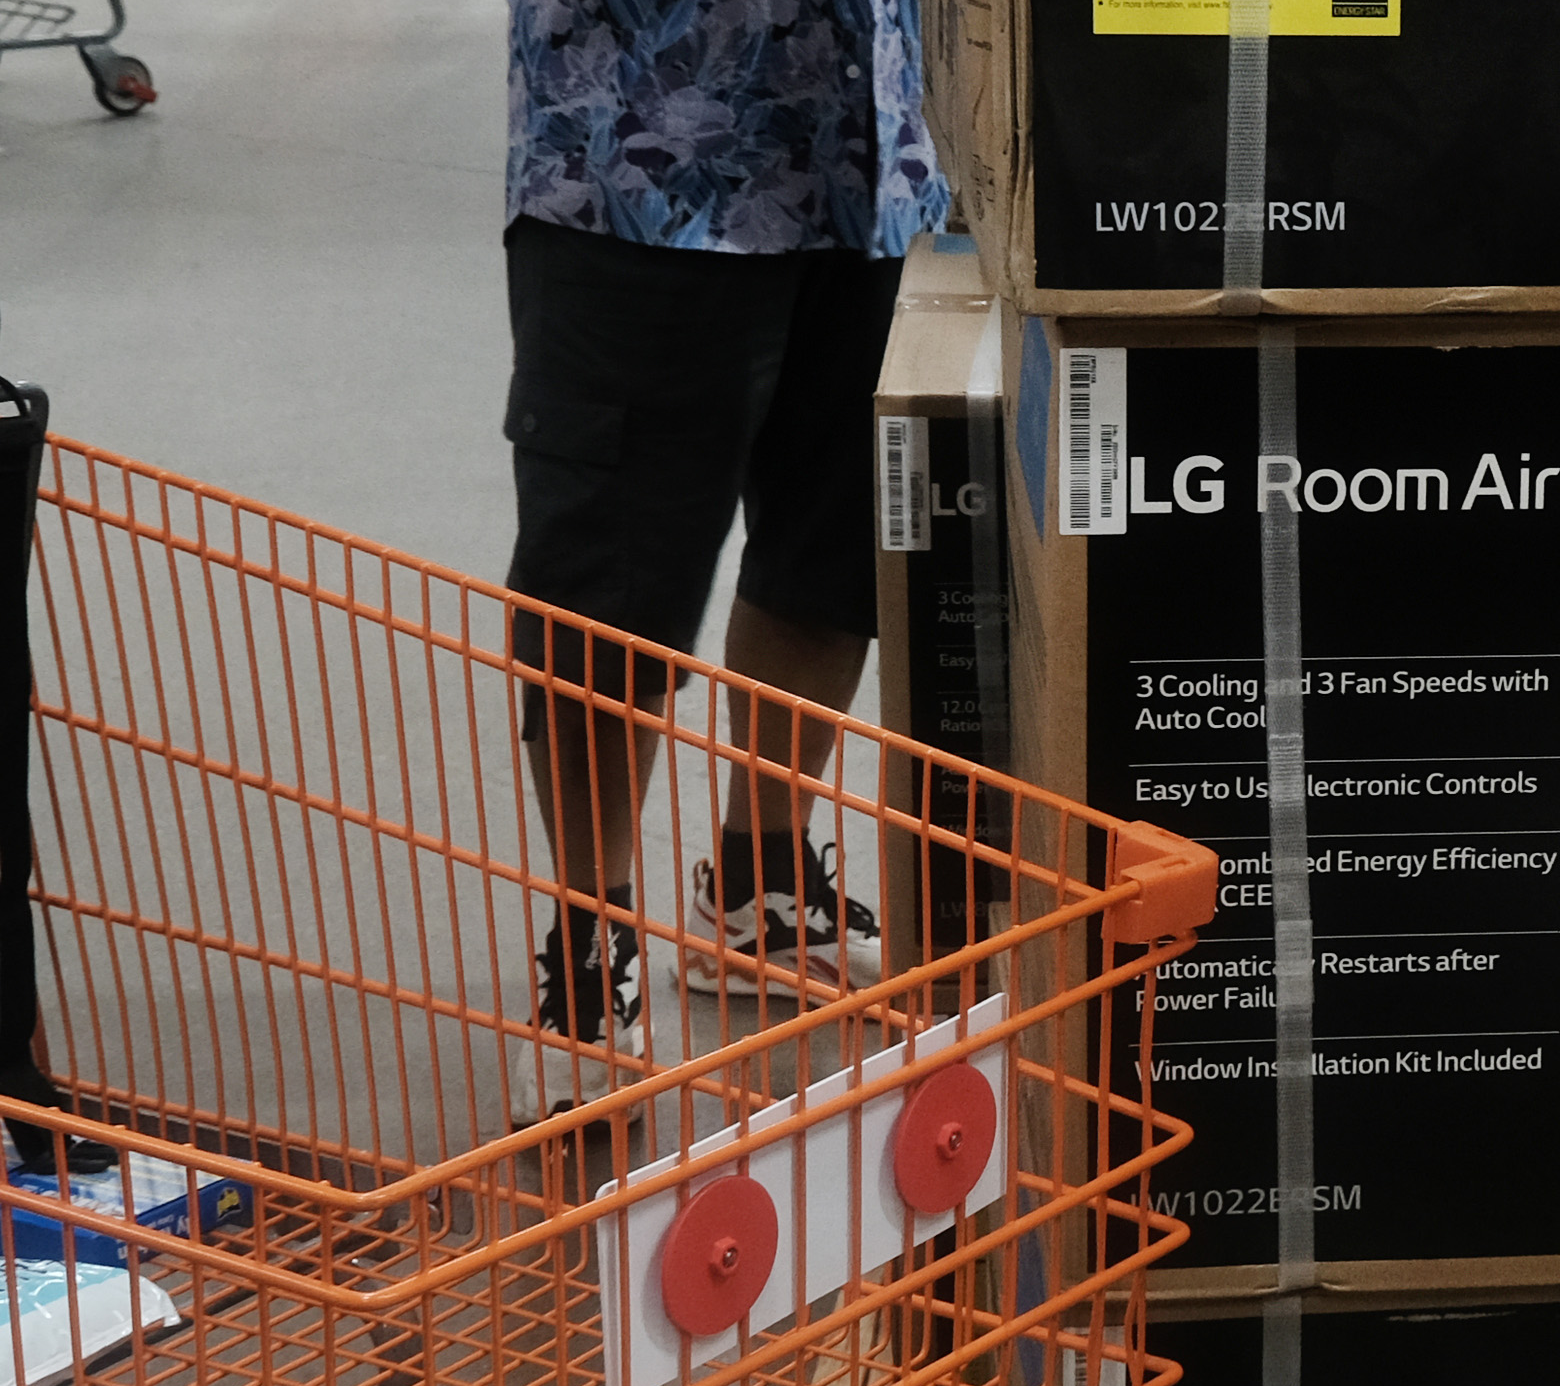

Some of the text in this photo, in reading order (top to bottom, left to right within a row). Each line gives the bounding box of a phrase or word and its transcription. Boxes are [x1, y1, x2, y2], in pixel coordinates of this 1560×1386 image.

[1129, 455, 1226, 514] LG
[1256, 454, 1449, 512] Room
[1158, 669, 1550, 703] Cooling Fan Speeds with
[1135, 771, 1538, 807] Easy Controls
[1338, 847, 1558, 879] Energy Efficiency
[1320, 949, 1500, 977] Restarts after
[1436, 1048, 1542, 1073] Included
